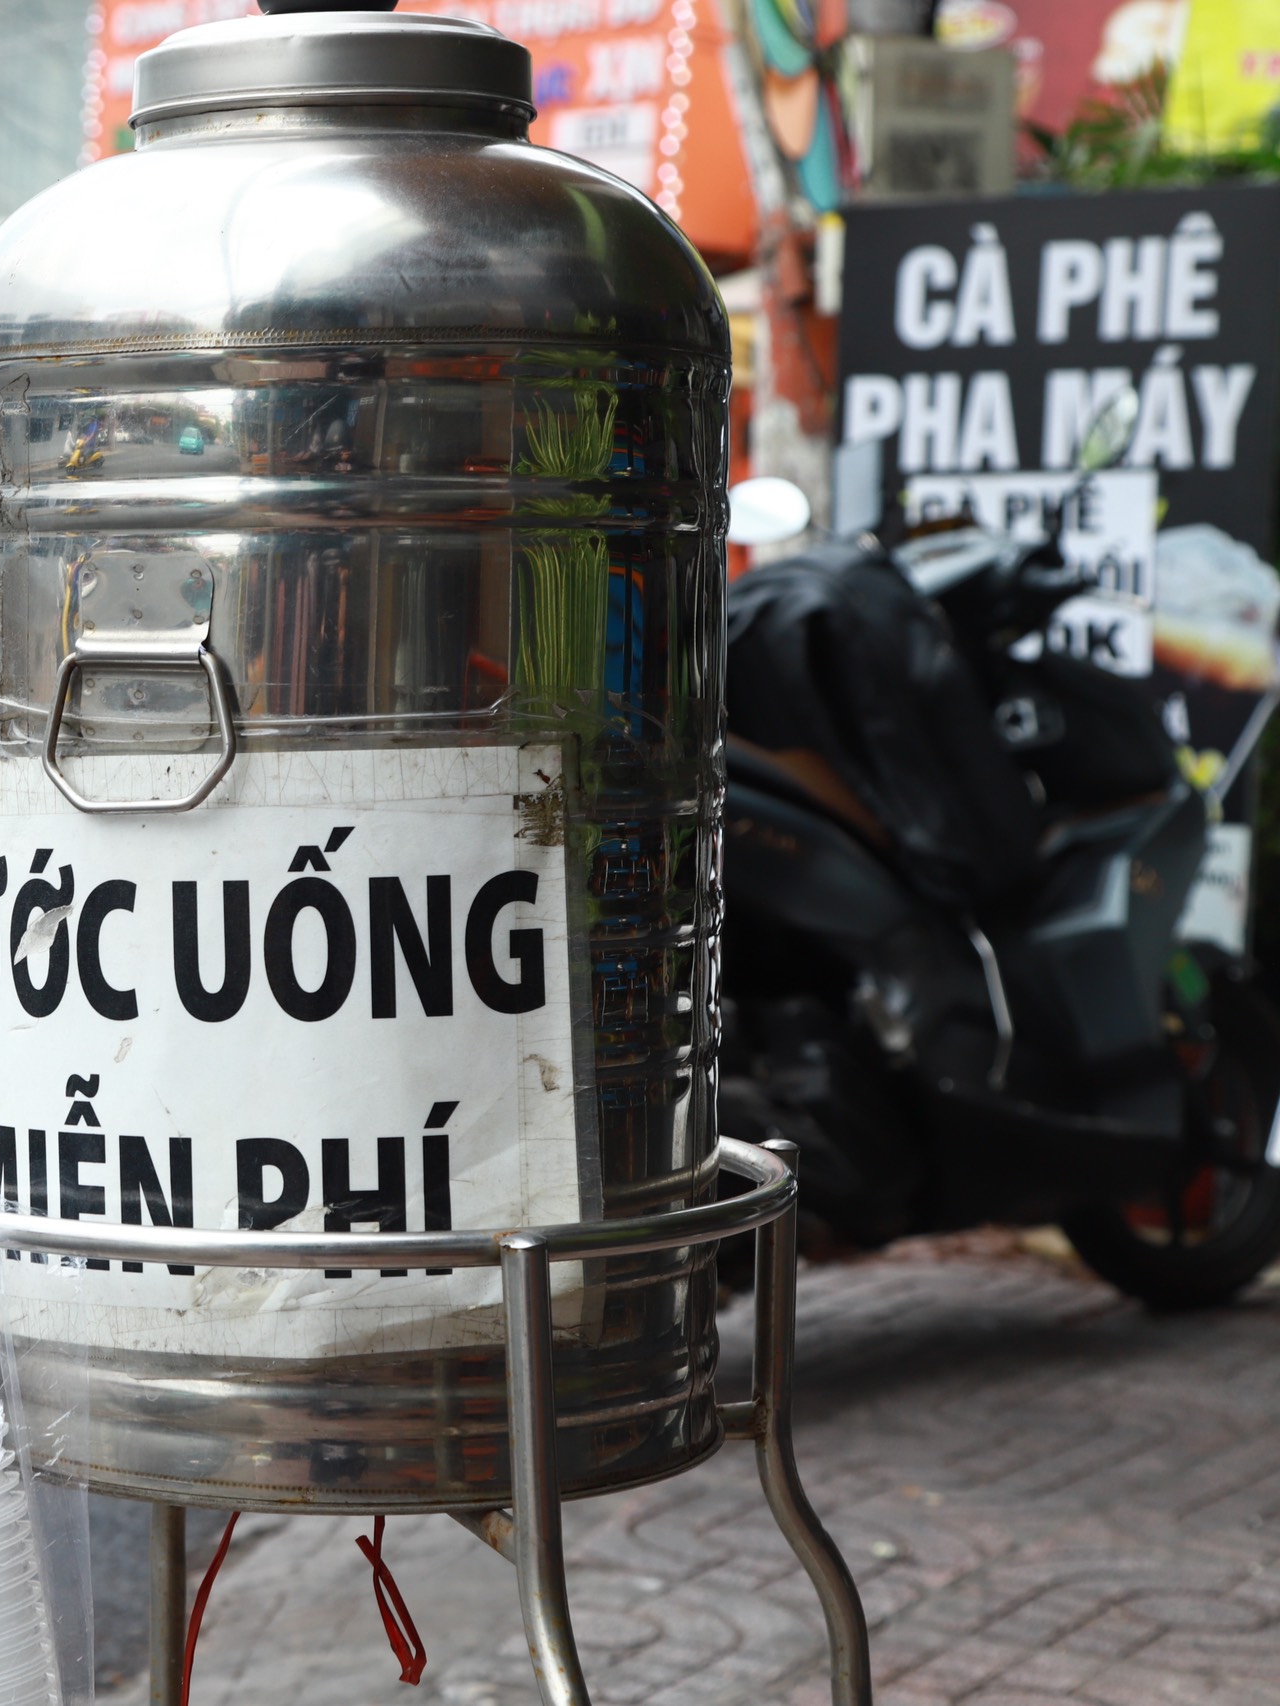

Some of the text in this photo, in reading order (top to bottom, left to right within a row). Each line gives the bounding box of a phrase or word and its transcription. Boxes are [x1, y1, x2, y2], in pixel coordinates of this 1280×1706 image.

[895, 211, 1223, 350] CÀ PHÊ
[844, 344, 1257, 473] PHA MÁY
[172, 826, 547, 1022] UỐNG
[235, 1100, 461, 1279] PHÍ
